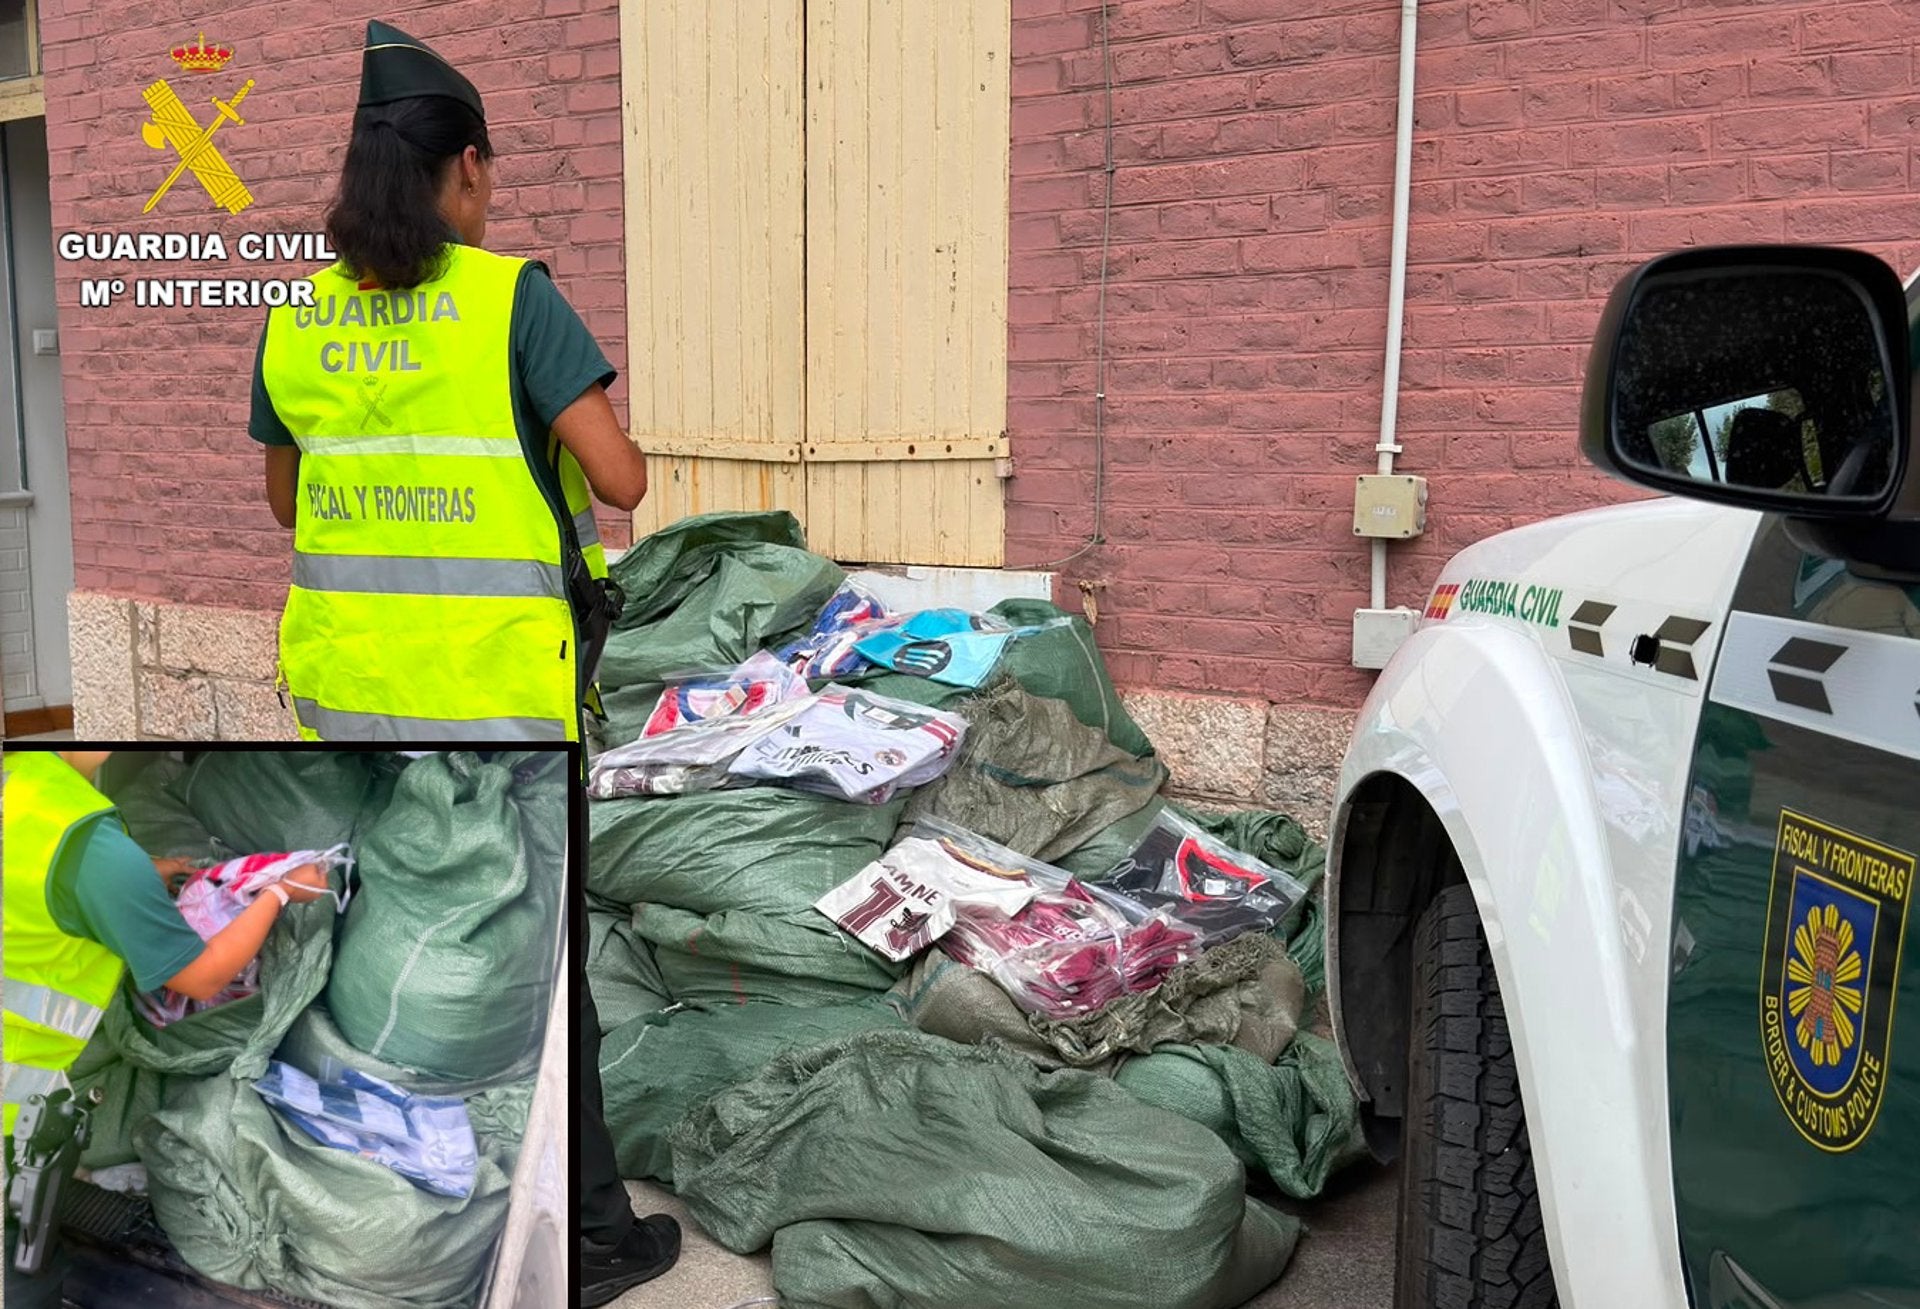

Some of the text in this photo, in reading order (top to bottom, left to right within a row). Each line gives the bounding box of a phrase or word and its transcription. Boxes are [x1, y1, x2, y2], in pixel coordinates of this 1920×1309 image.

[295, 291, 461, 329] GUARDIA
[320, 339, 422, 373] CIVIL
[353, 485, 367, 520] Y
[373, 485, 476, 524] FRONTERAS
[1460, 578, 1563, 627] GUARDIA CIVIL
[1782, 824, 1906, 900] FISCAL Y FRONTERAS
[1765, 995, 1880, 1138] BORDER & CUSTOMS POLICE
